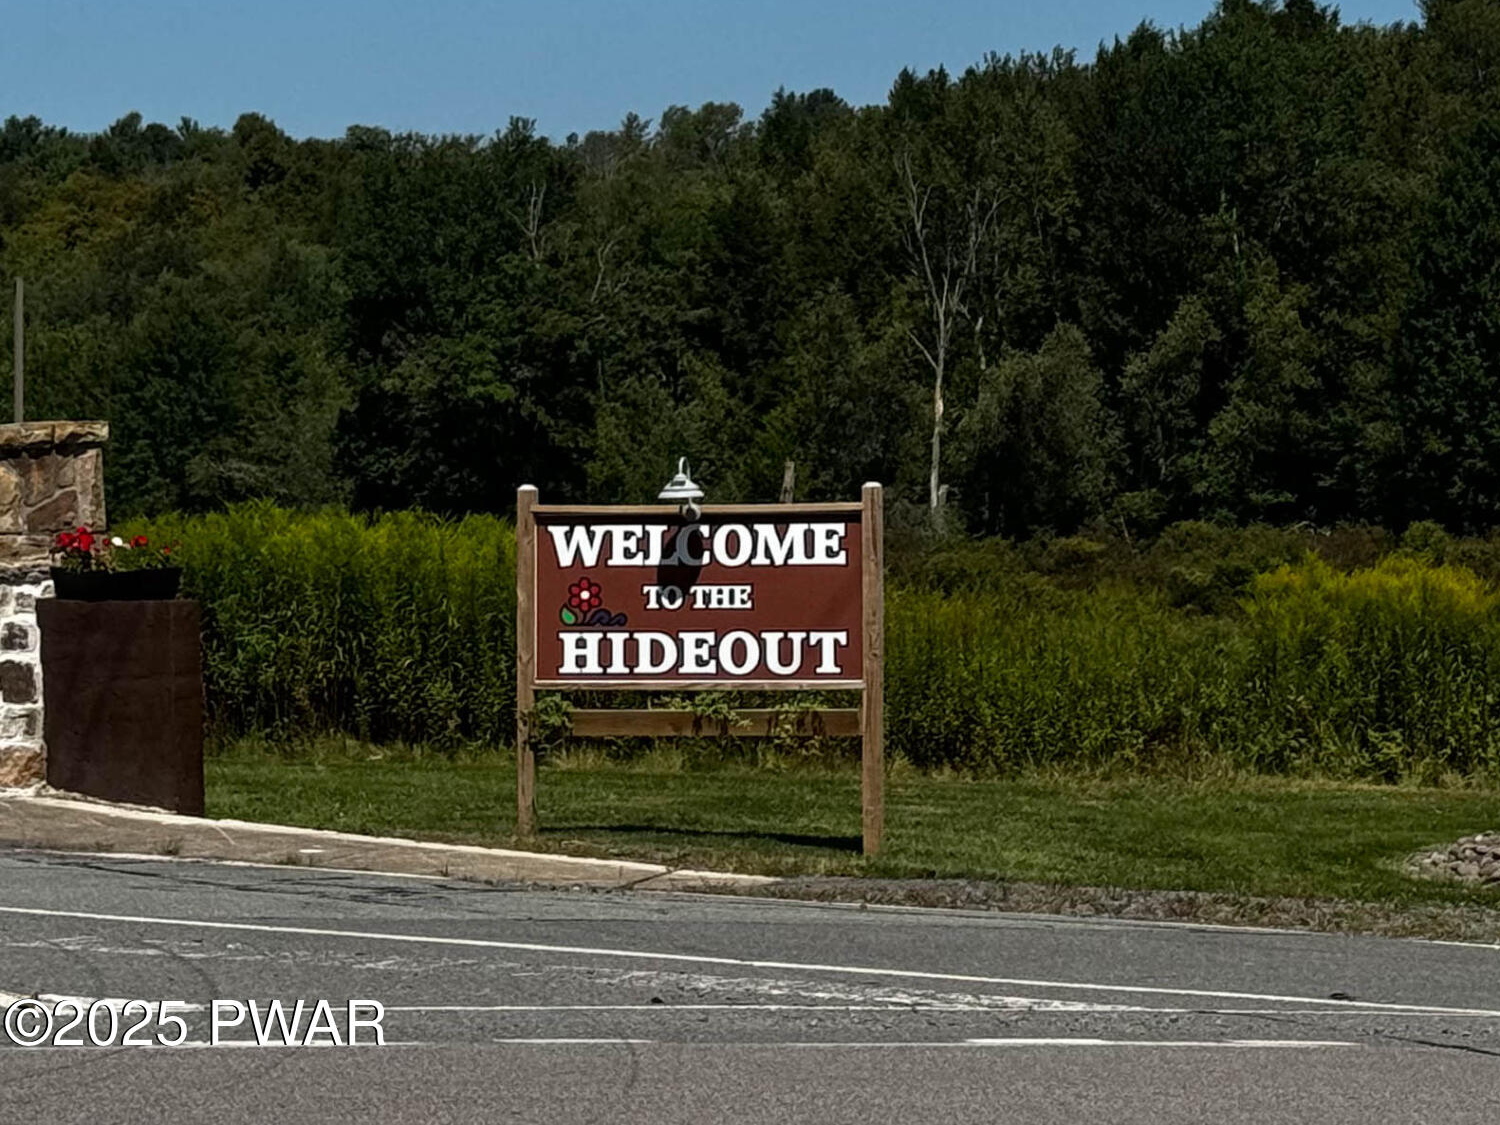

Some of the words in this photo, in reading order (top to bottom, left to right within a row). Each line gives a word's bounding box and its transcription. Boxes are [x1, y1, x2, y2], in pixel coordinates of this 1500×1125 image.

[547, 522, 848, 568] WELCOME
[642, 584, 683, 610] TO
[690, 584, 753, 610] THE
[557, 630, 848, 675] HIDEOUT
